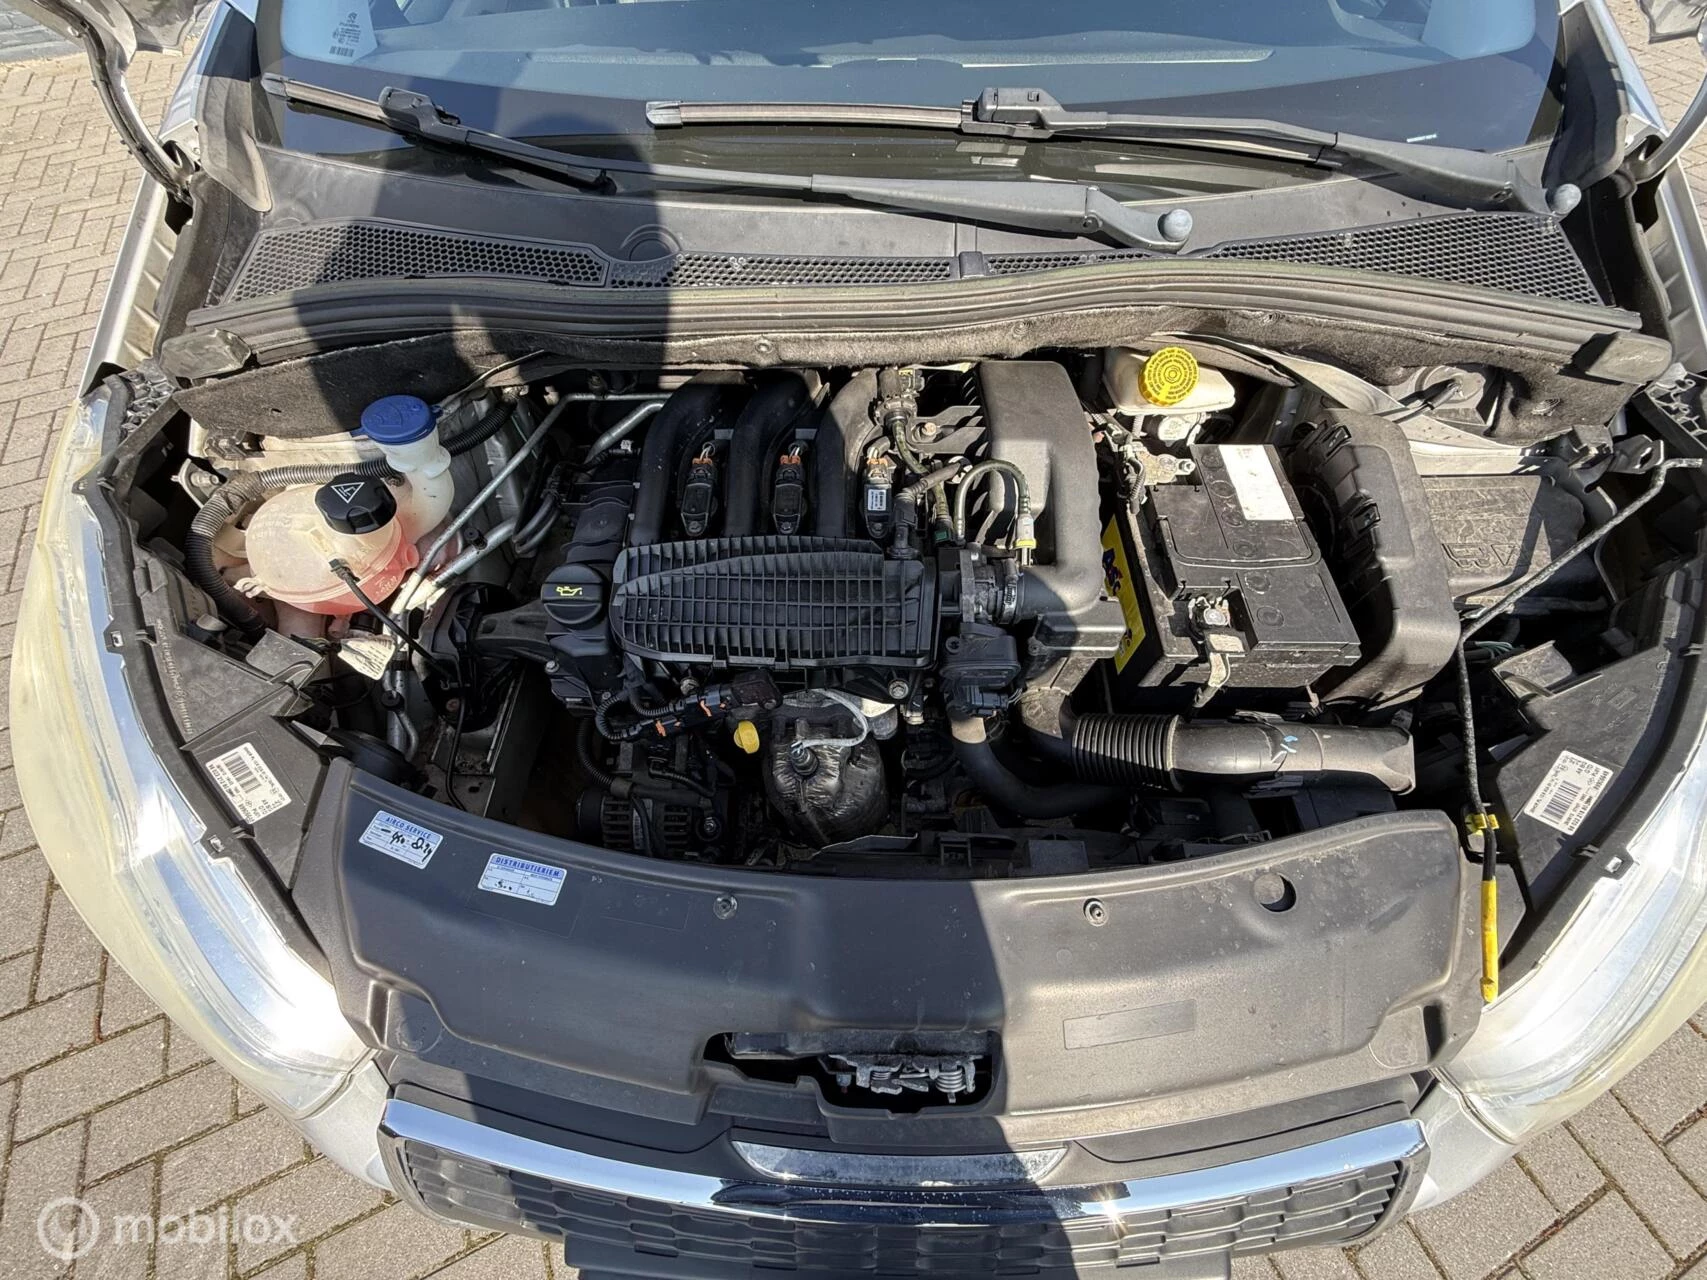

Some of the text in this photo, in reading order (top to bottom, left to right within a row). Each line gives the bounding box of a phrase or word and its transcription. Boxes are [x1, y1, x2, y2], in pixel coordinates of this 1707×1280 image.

[386, 817, 405, 829] AIRCO
[406, 824, 432, 840] SERVICE
[495, 856, 560, 877] DISTRIBUTIERIEM
